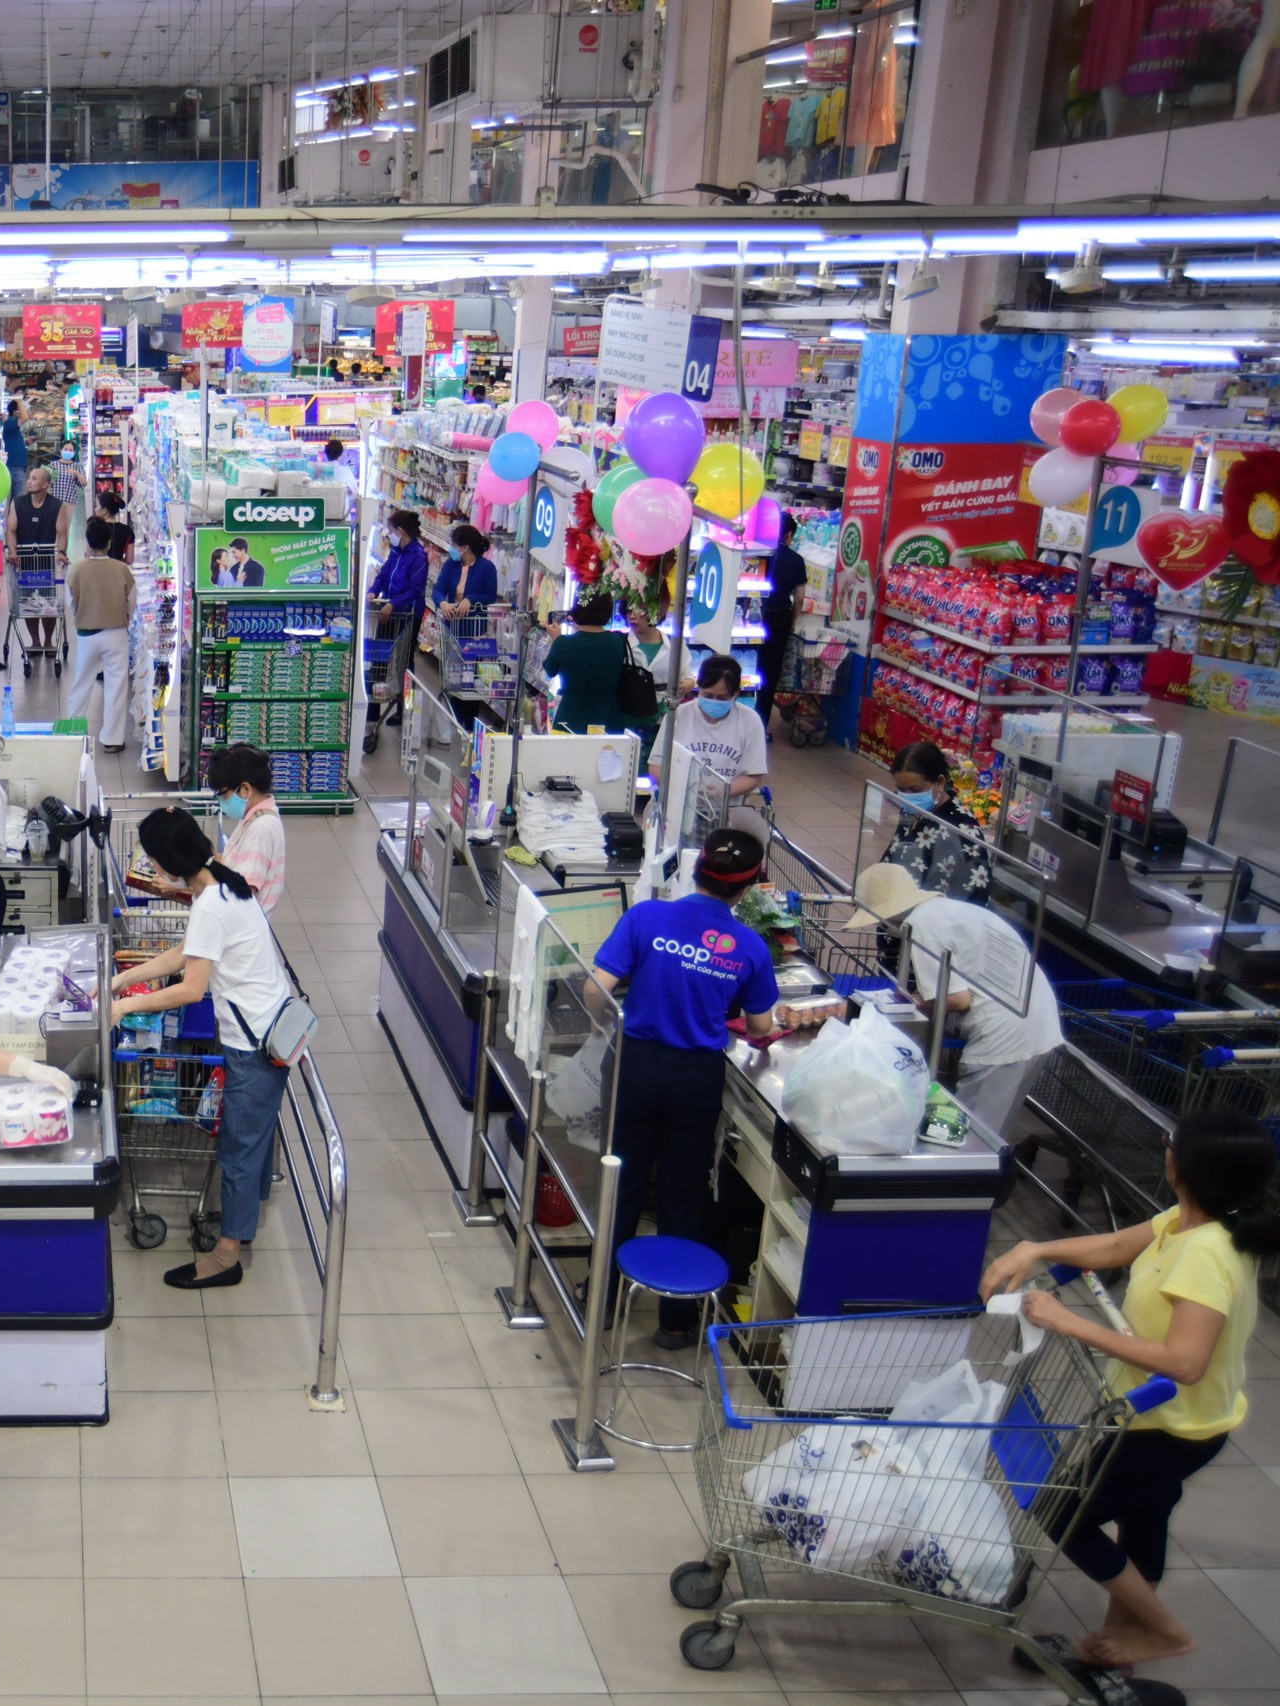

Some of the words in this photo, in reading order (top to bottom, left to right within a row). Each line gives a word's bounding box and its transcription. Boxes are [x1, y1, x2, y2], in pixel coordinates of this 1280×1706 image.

[40, 321, 64, 342] 35
[567, 329, 580, 342] LỐI
[685, 360, 711, 396] 04
[863, 450, 879, 469] OMO
[912, 450, 945, 468] OMO
[915, 467, 937, 475] MATIC
[933, 478, 978, 498] ĐÁNH
[980, 475, 1015, 491] BAY
[921, 500, 940, 512] VẾT
[966, 493, 995, 506] CỨNG
[232, 501, 315, 528] closeup
[535, 496, 555, 537] 09
[1102, 499, 1128, 533] 11
[270, 543, 292, 555] THƠM
[292, 540, 308, 550] MÁT
[308, 537, 322, 548] DÀI
[322, 534, 336, 545] LÂU
[318, 543, 336, 553] 99%
[896, 540, 940, 564] POLYSHIELD
[1156, 527, 1210, 560] 35
[699, 562, 718, 608] 10
[1013, 616, 1037, 627] OMO
[686, 742, 742, 764] LIFORNIA
[681, 960, 696, 970] bạn
[696, 964, 712, 975] của
[712, 969, 726, 980] mọi
